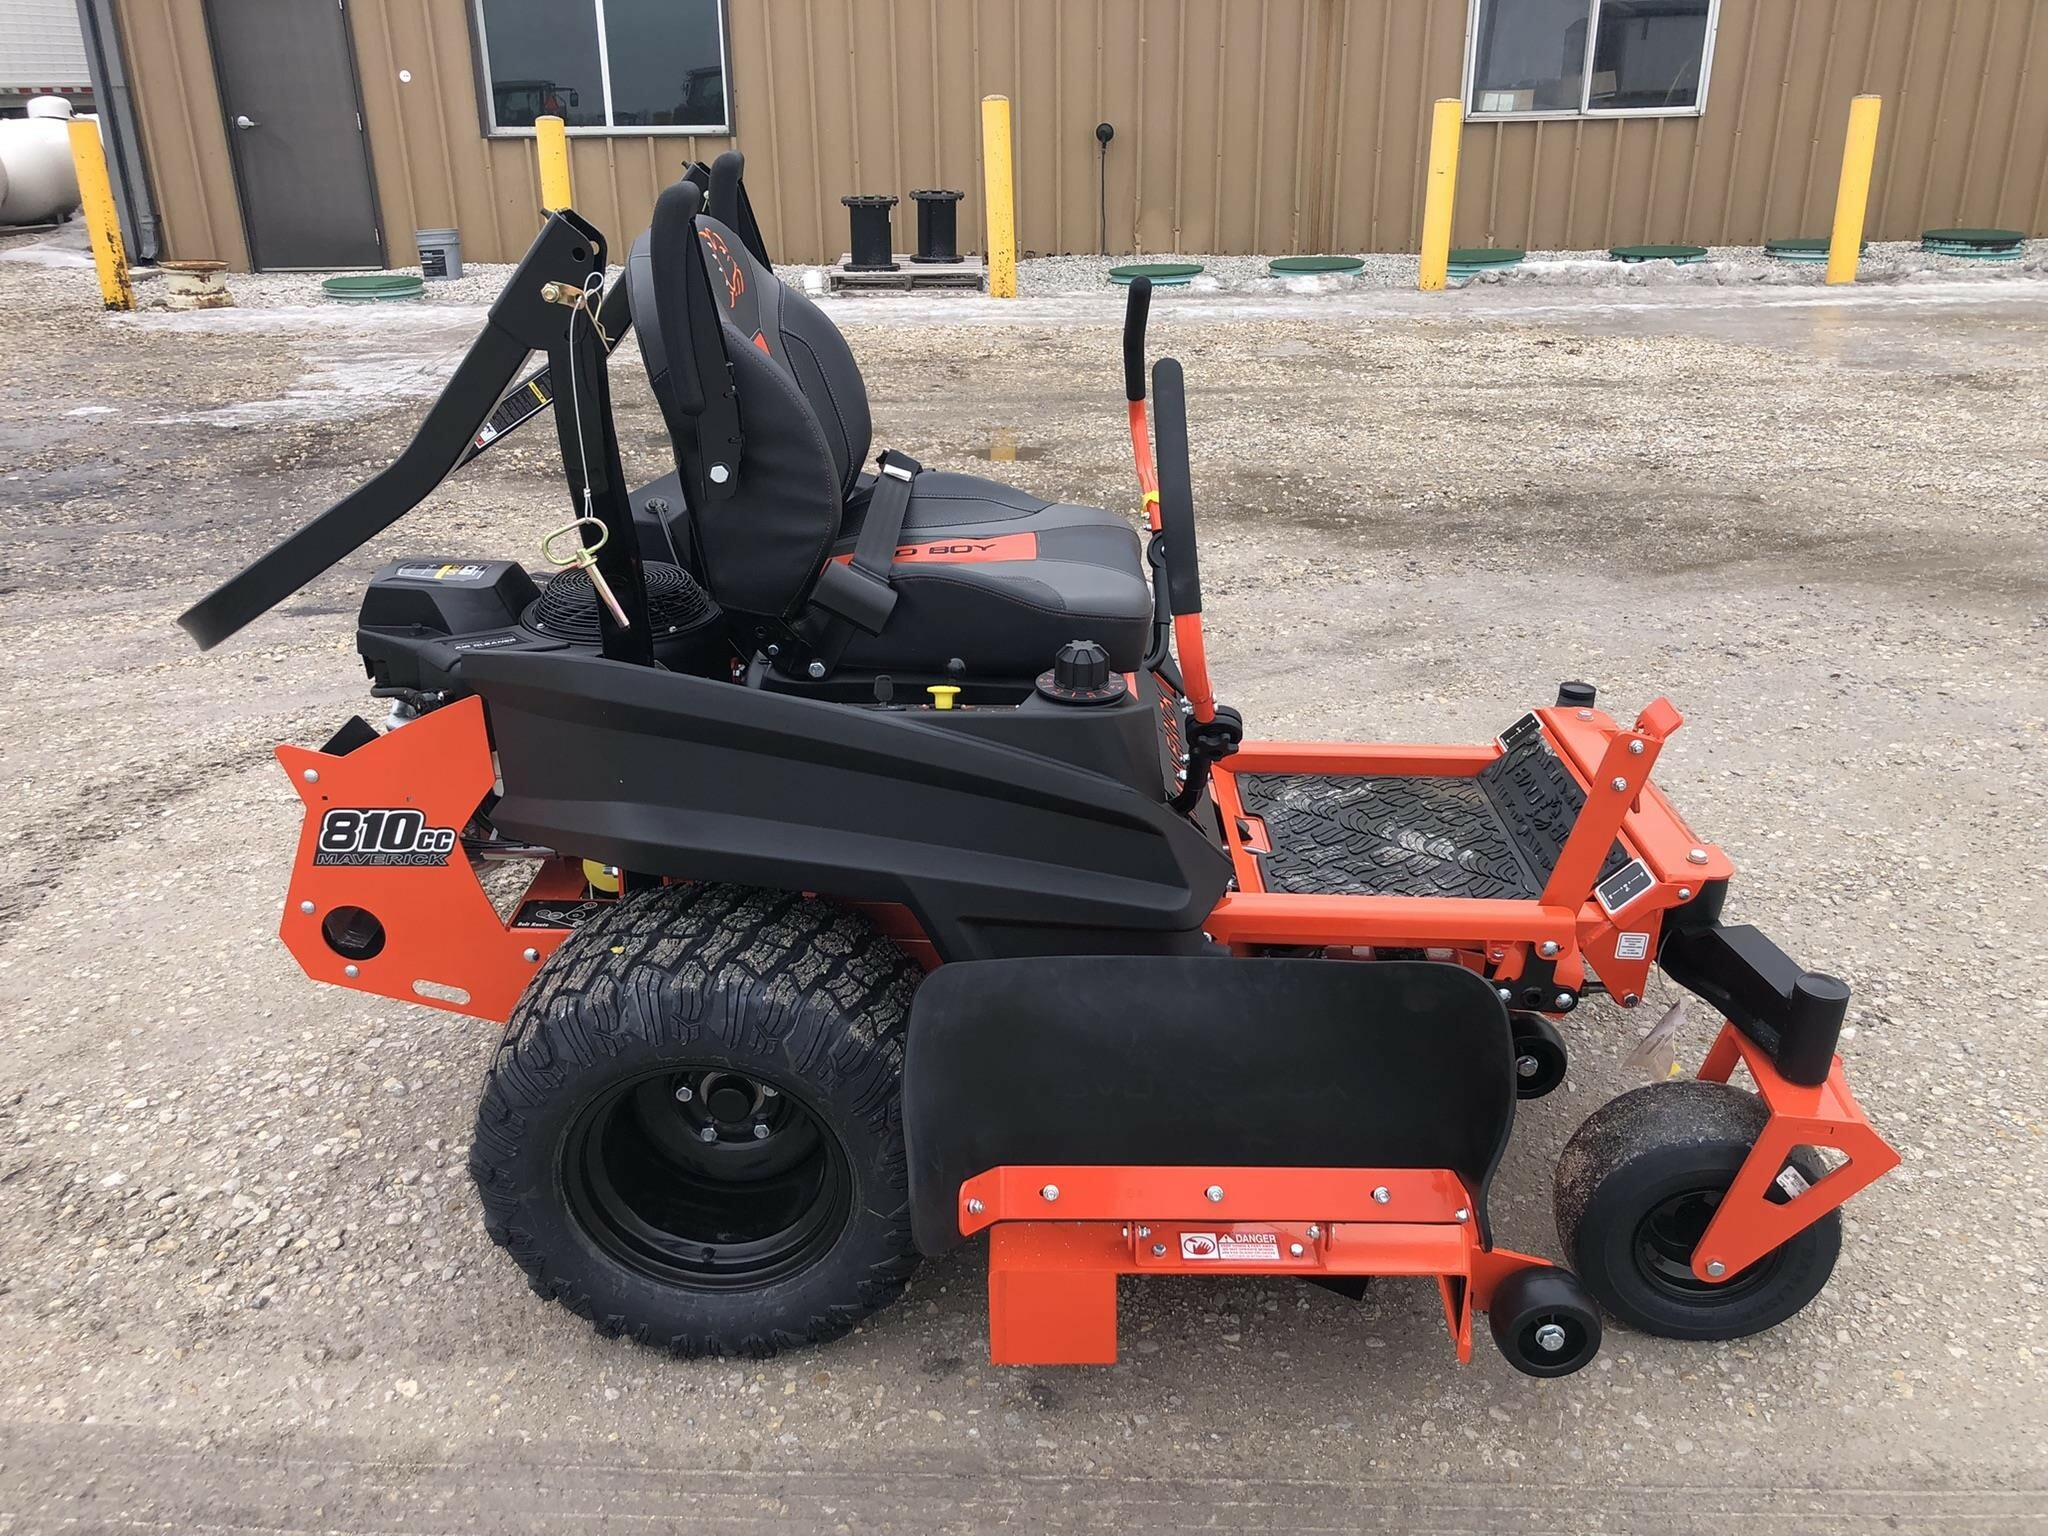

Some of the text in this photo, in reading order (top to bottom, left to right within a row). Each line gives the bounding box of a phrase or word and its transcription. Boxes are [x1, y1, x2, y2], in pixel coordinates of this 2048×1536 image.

[929, 543, 997, 554] BOY
[318, 808, 456, 853] 810cc
[316, 853, 448, 866] MAVERICK
[1235, 1233, 1276, 1243] DANGER
